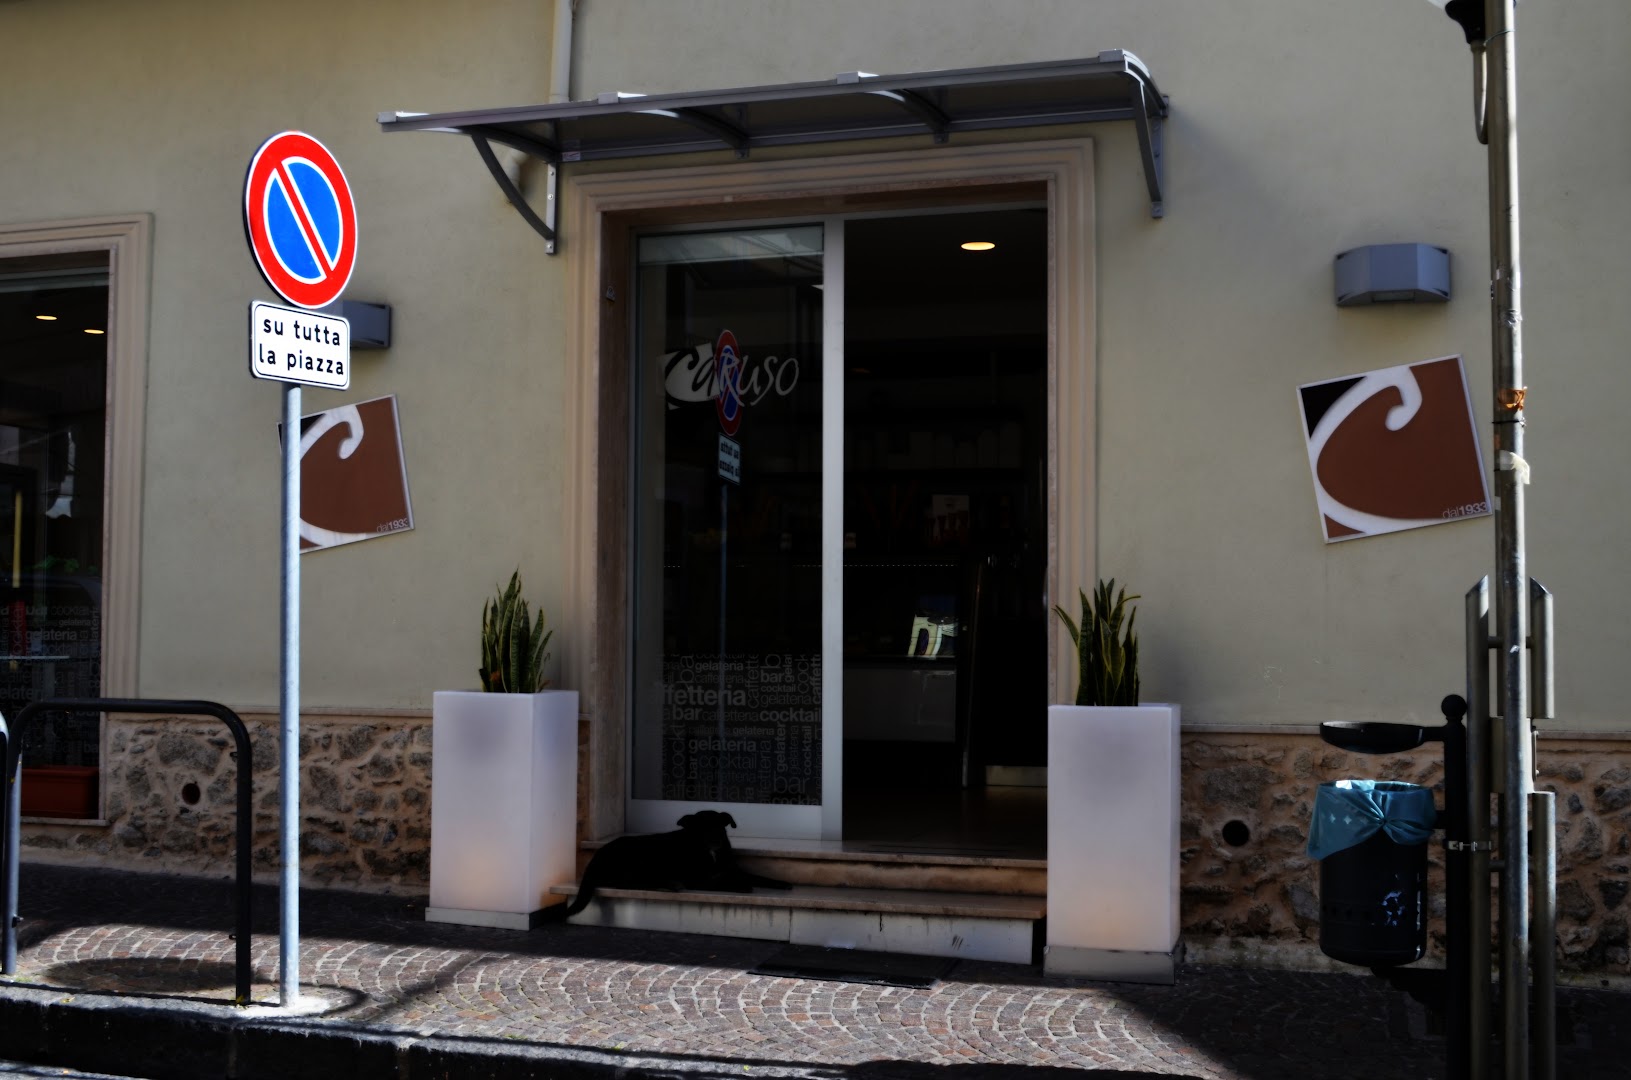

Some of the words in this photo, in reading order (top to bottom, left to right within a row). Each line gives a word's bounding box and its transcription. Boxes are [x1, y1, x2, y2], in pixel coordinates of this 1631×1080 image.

[263, 319, 284, 336] su
[293, 320, 341, 346] tutta
[259, 343, 276, 365] la
[287, 350, 344, 375] piazza
[694, 660, 744, 673] gelateria
[760, 669, 785, 683] bar
[760, 684, 797, 693] cocktail
[760, 692, 812, 708] gelateria
[671, 704, 703, 721] bar
[759, 707, 821, 722] cocktail
[732, 725, 775, 737] gelateria
[688, 736, 757, 755] gelateria
[801, 725, 812, 776] cocktail
[698, 752, 758, 769] cocktail
[773, 771, 811, 794] bar
